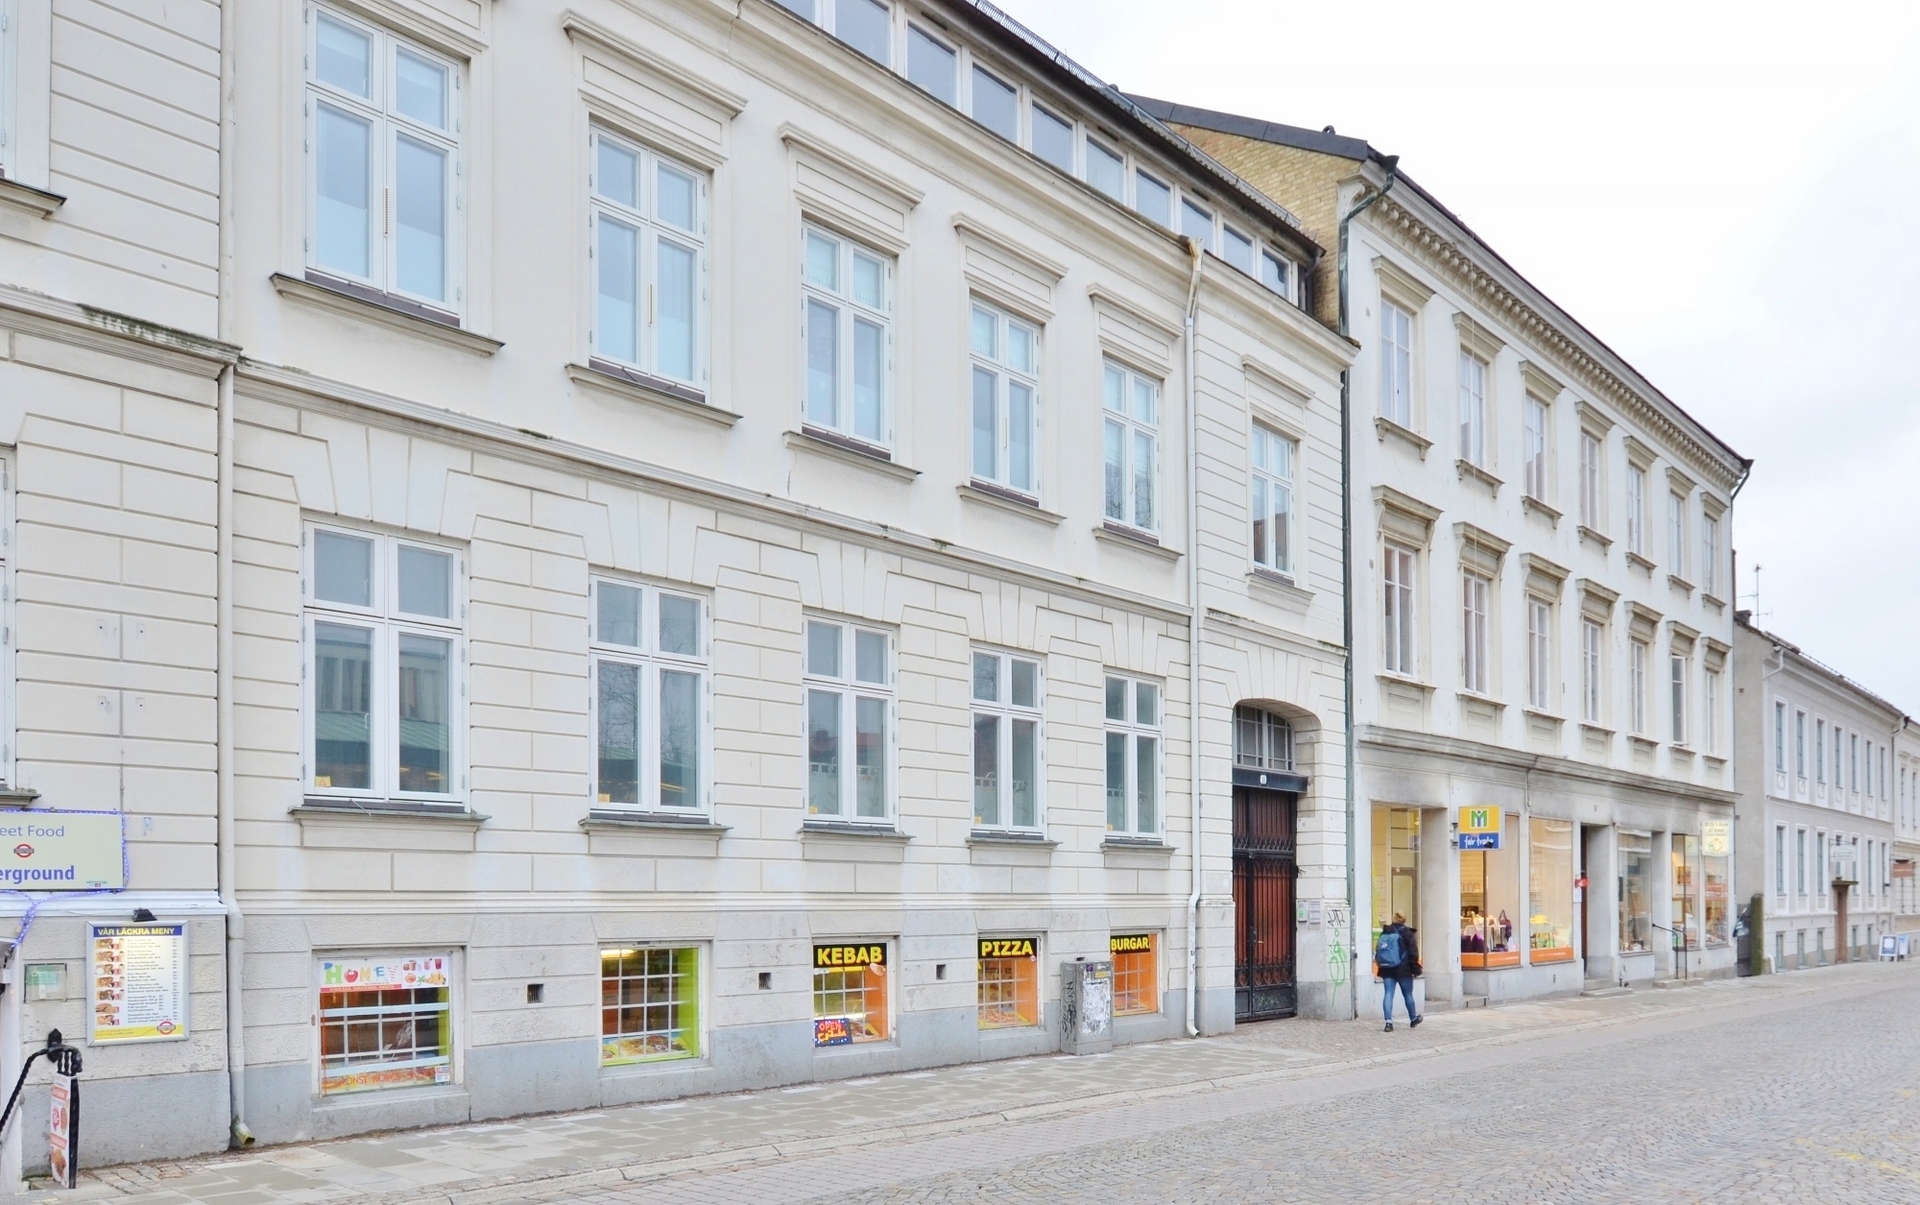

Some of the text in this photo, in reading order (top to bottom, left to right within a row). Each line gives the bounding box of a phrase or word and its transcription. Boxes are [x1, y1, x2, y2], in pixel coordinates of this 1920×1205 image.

[28, 825, 65, 837] Food
[98, 927, 175, 936] VÅR LÄCKRA MENY
[981, 940, 1034, 957] PIZZA
[1111, 937, 1151, 951] BURGAR
[817, 946, 883, 965] KEBAB
[324, 962, 398, 985] HONEY
[818, 1021, 842, 1032] OPEN
